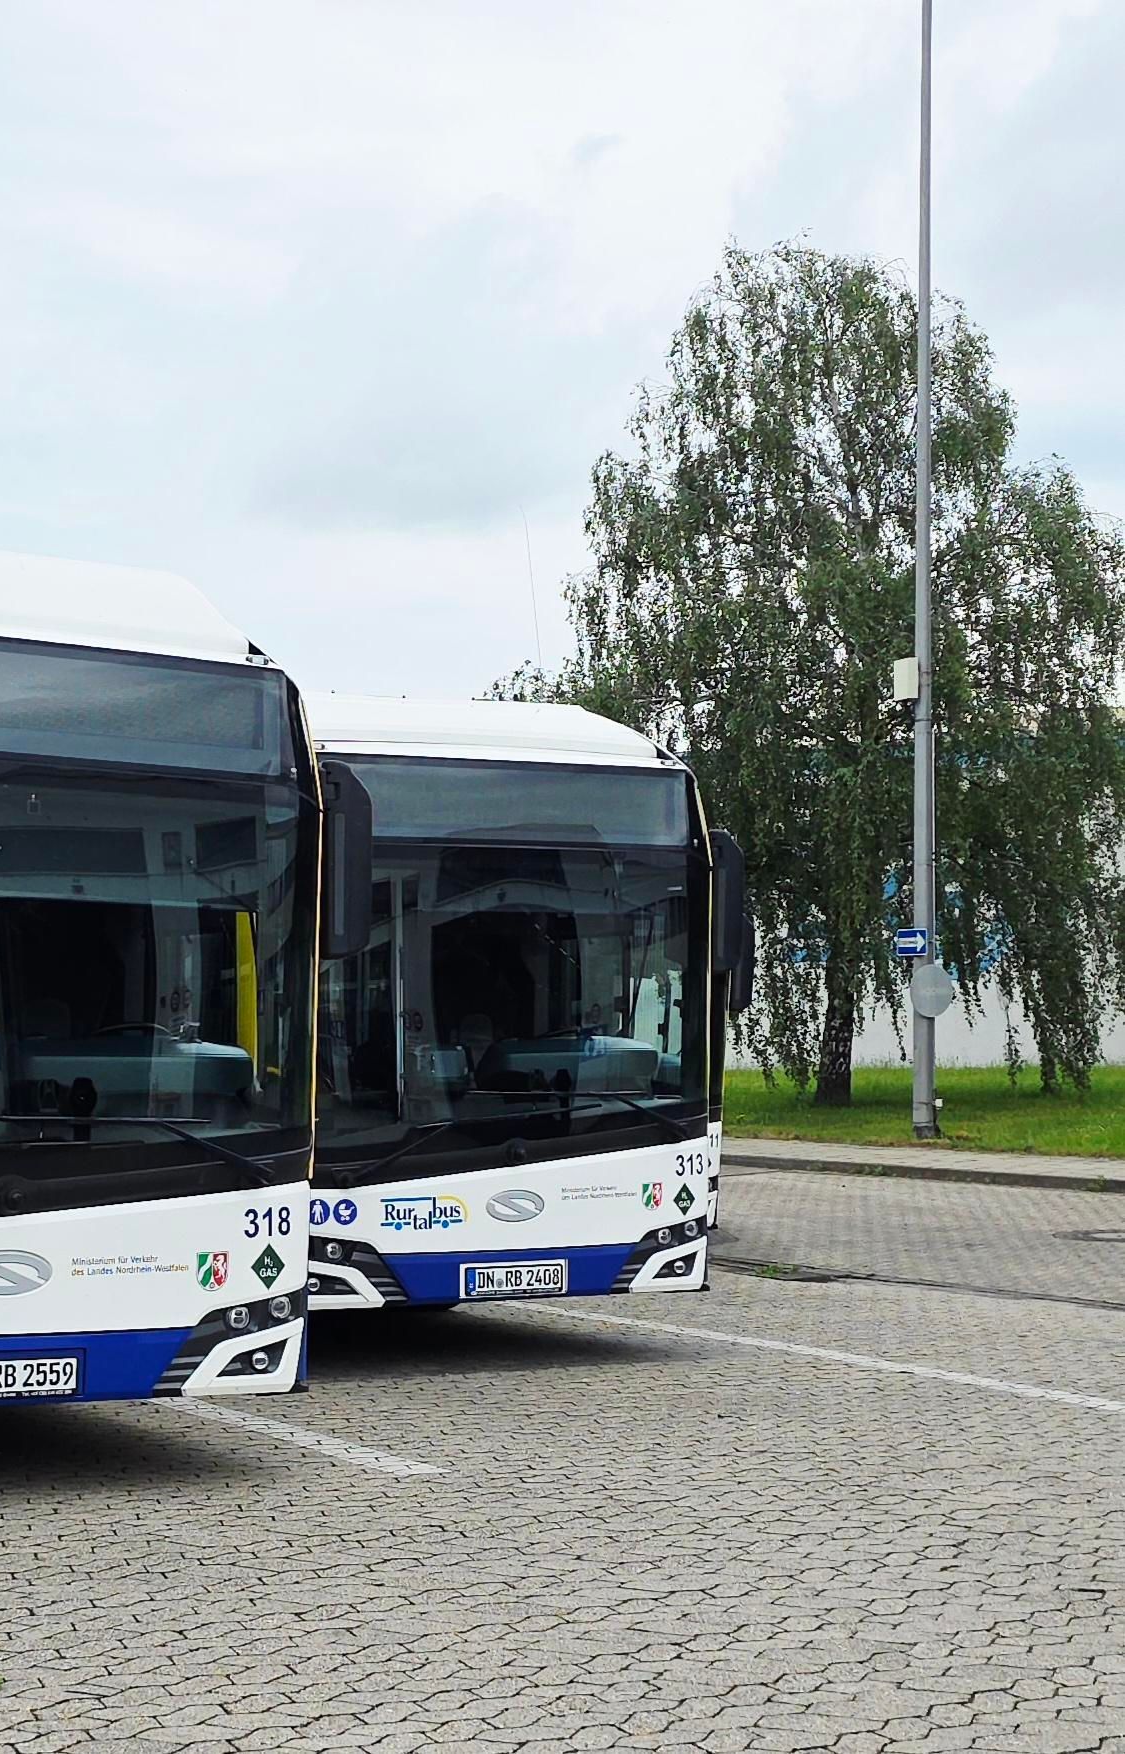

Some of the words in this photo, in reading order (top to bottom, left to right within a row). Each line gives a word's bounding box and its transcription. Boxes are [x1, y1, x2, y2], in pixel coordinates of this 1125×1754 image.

[675, 1153, 704, 1177] 313
[243, 1206, 291, 1239] 318
[71, 1257, 116, 1266] Ministerium
[118, 1255, 128, 1264] für
[130, 1255, 158, 1263] Verkehr
[71, 1267, 84, 1276] des
[87, 1266, 114, 1276] Landes
[116, 1264, 189, 1275] Nordrhein-Westfalen
[259, 1267, 278, 1278] GAS
[477, 1270, 495, 1289] DN
[505, 1269, 523, 1288] RB
[526, 1268, 560, 1287] 2408
[22, 1361, 74, 1388] 2559
